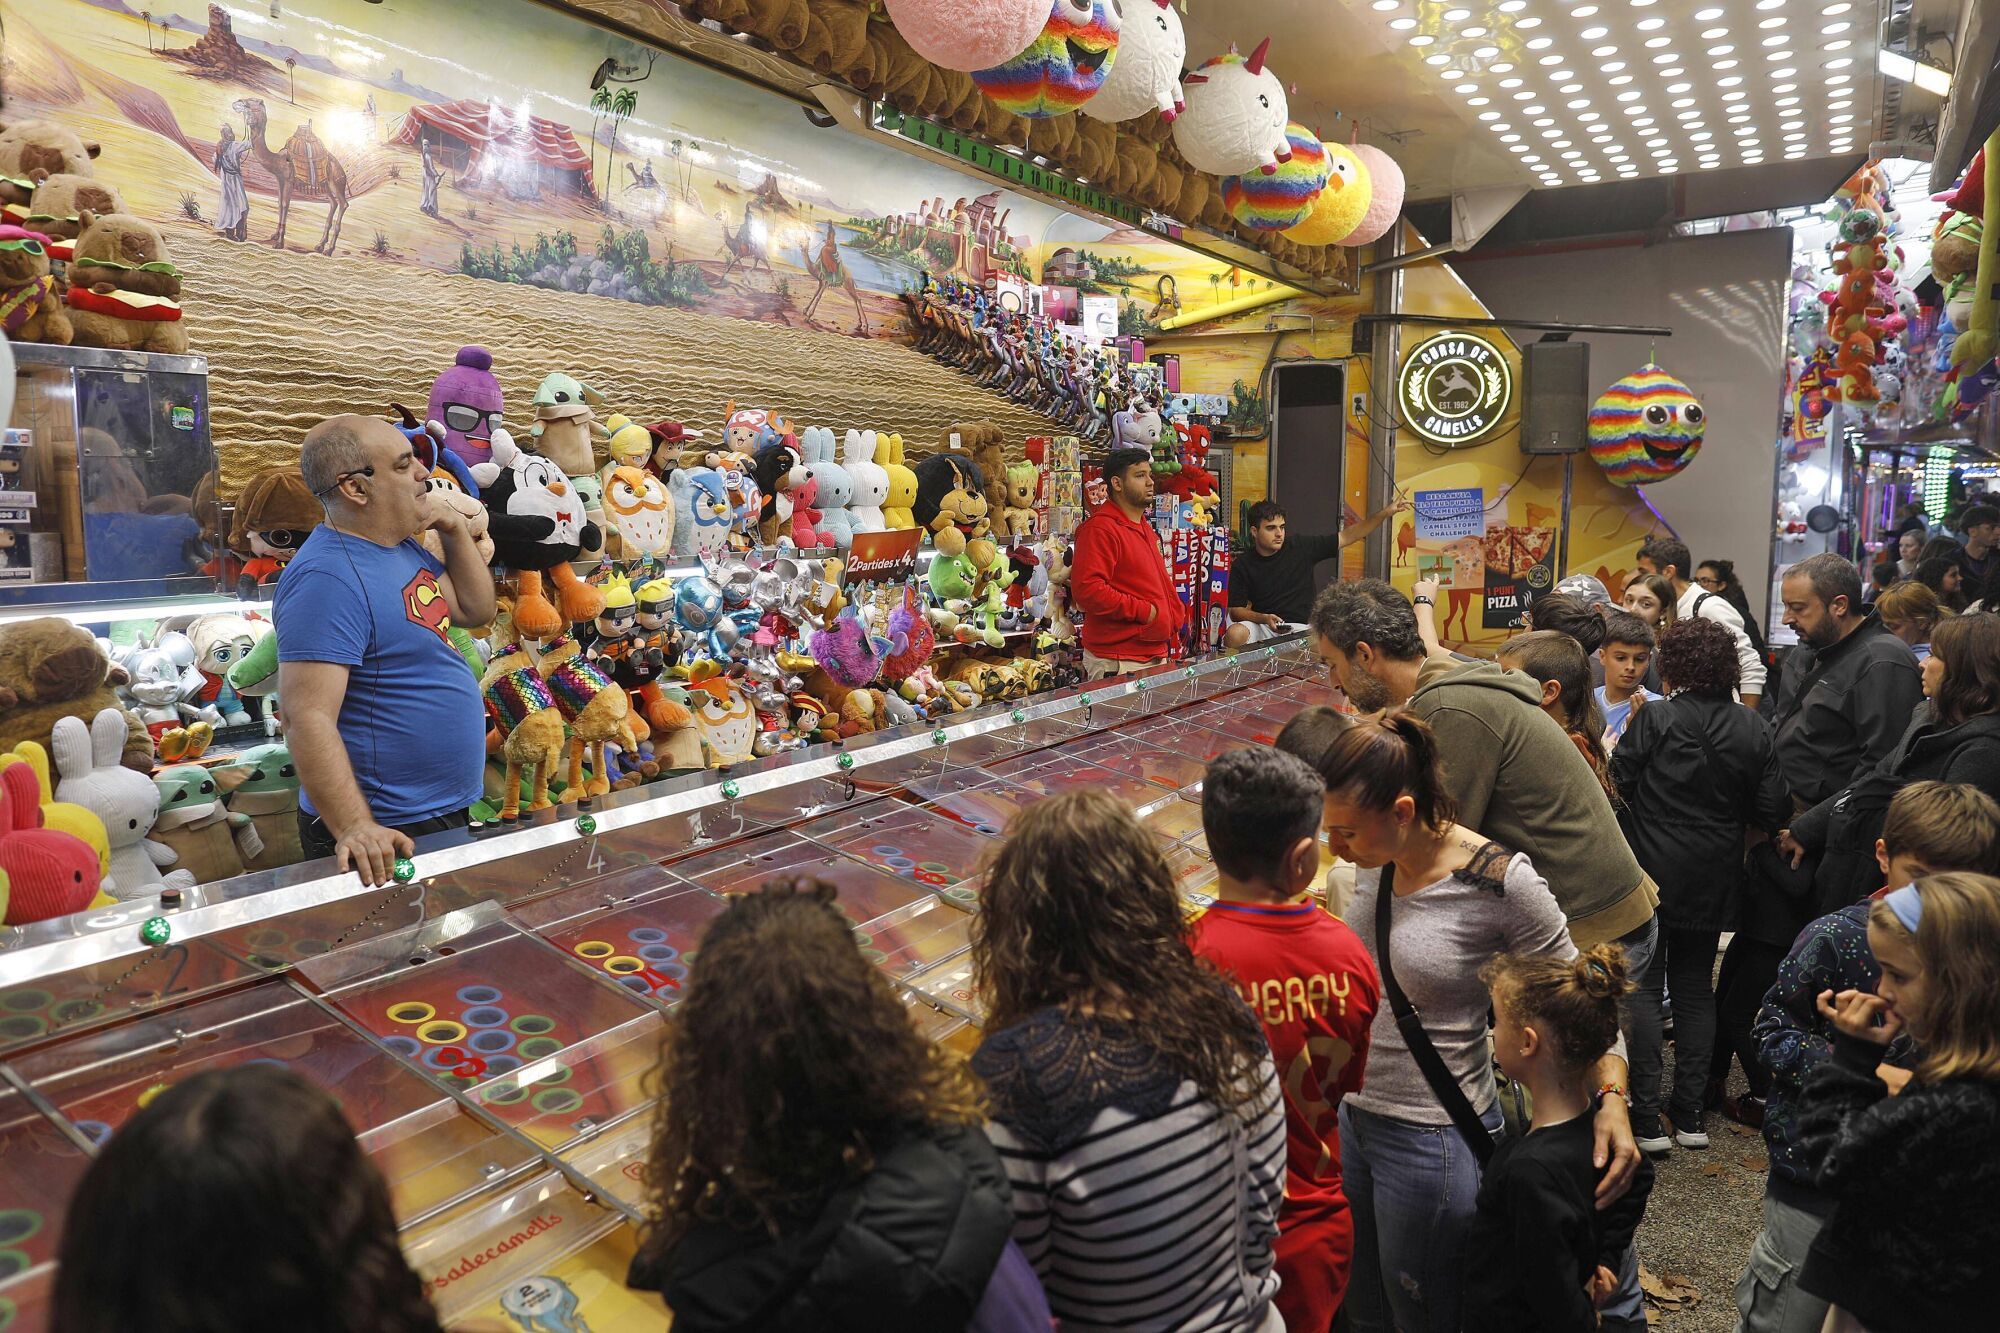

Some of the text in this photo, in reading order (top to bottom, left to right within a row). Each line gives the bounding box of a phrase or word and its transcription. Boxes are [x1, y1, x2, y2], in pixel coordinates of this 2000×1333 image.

[936, 130, 944, 149] 4
[954, 138, 960, 155] 5
[971, 145, 977, 161] 6
[987, 152, 993, 168] 7
[1018, 164, 1024, 180] 9
[1031, 169, 1040, 186] 10
[1045, 174, 1053, 191] 11
[1059, 181, 1067, 196] 12
[1072, 186, 1080, 201] 13
[1085, 191, 1093, 206] 14
[1098, 196, 1105, 211] 15
[1421, 342, 1489, 364] CURSA DE
[1454, 401, 1469, 409] 1982
[1425, 415, 1483, 435] CAMELLS
[1211, 580, 1222, 593] 8
[1493, 585, 1516, 596] PUNT
[1487, 595, 1518, 609] PIZZA
[730, 798, 744, 837] 5
[587, 836, 606, 874] 4
[160, 944, 189, 996] 2
[631, 967, 681, 990] 4
[1235, 971, 1350, 1025] YERAY
[520, 1285, 535, 1298] 2
